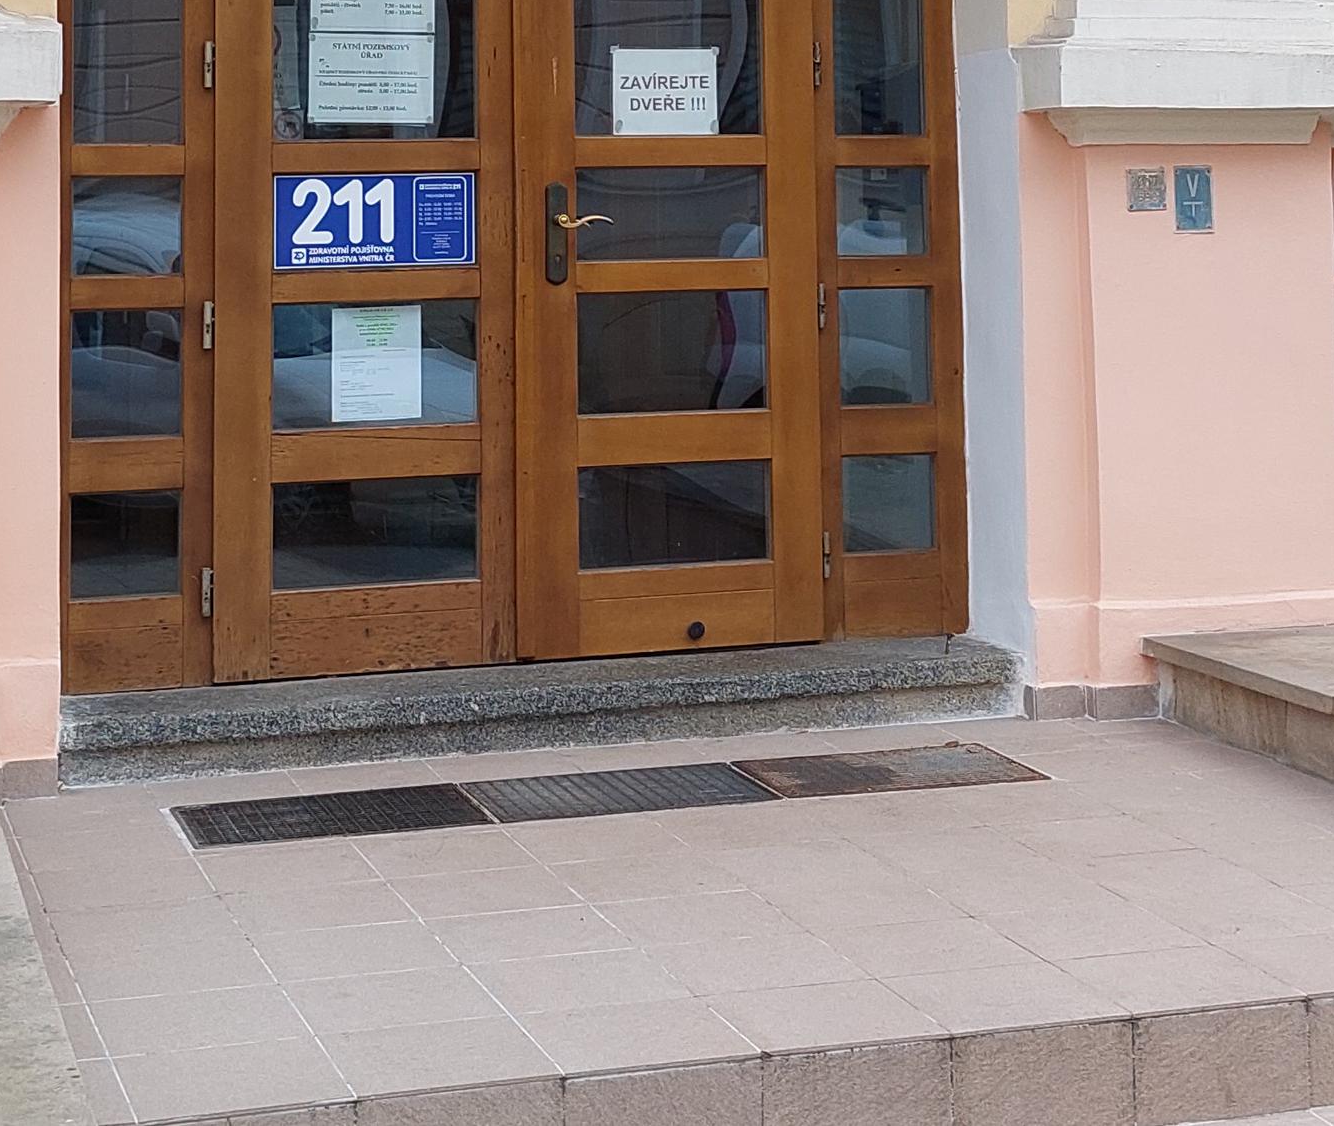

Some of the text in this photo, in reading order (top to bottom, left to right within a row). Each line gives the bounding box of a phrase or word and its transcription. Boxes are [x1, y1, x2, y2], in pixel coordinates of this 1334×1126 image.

[360, 51, 383, 59] ÚŘAD
[620, 73, 709, 90] ZAVÍREJTE
[630, 94, 706, 111] DVEŘE !!!
[292, 178, 394, 244] 211
[308, 245, 349, 255] ZDRAVOTNÍ
[350, 244, 394, 254] POJIŠŤOVNA
[308, 252, 395, 263] MINISTERSTVA VNITRA ČR
